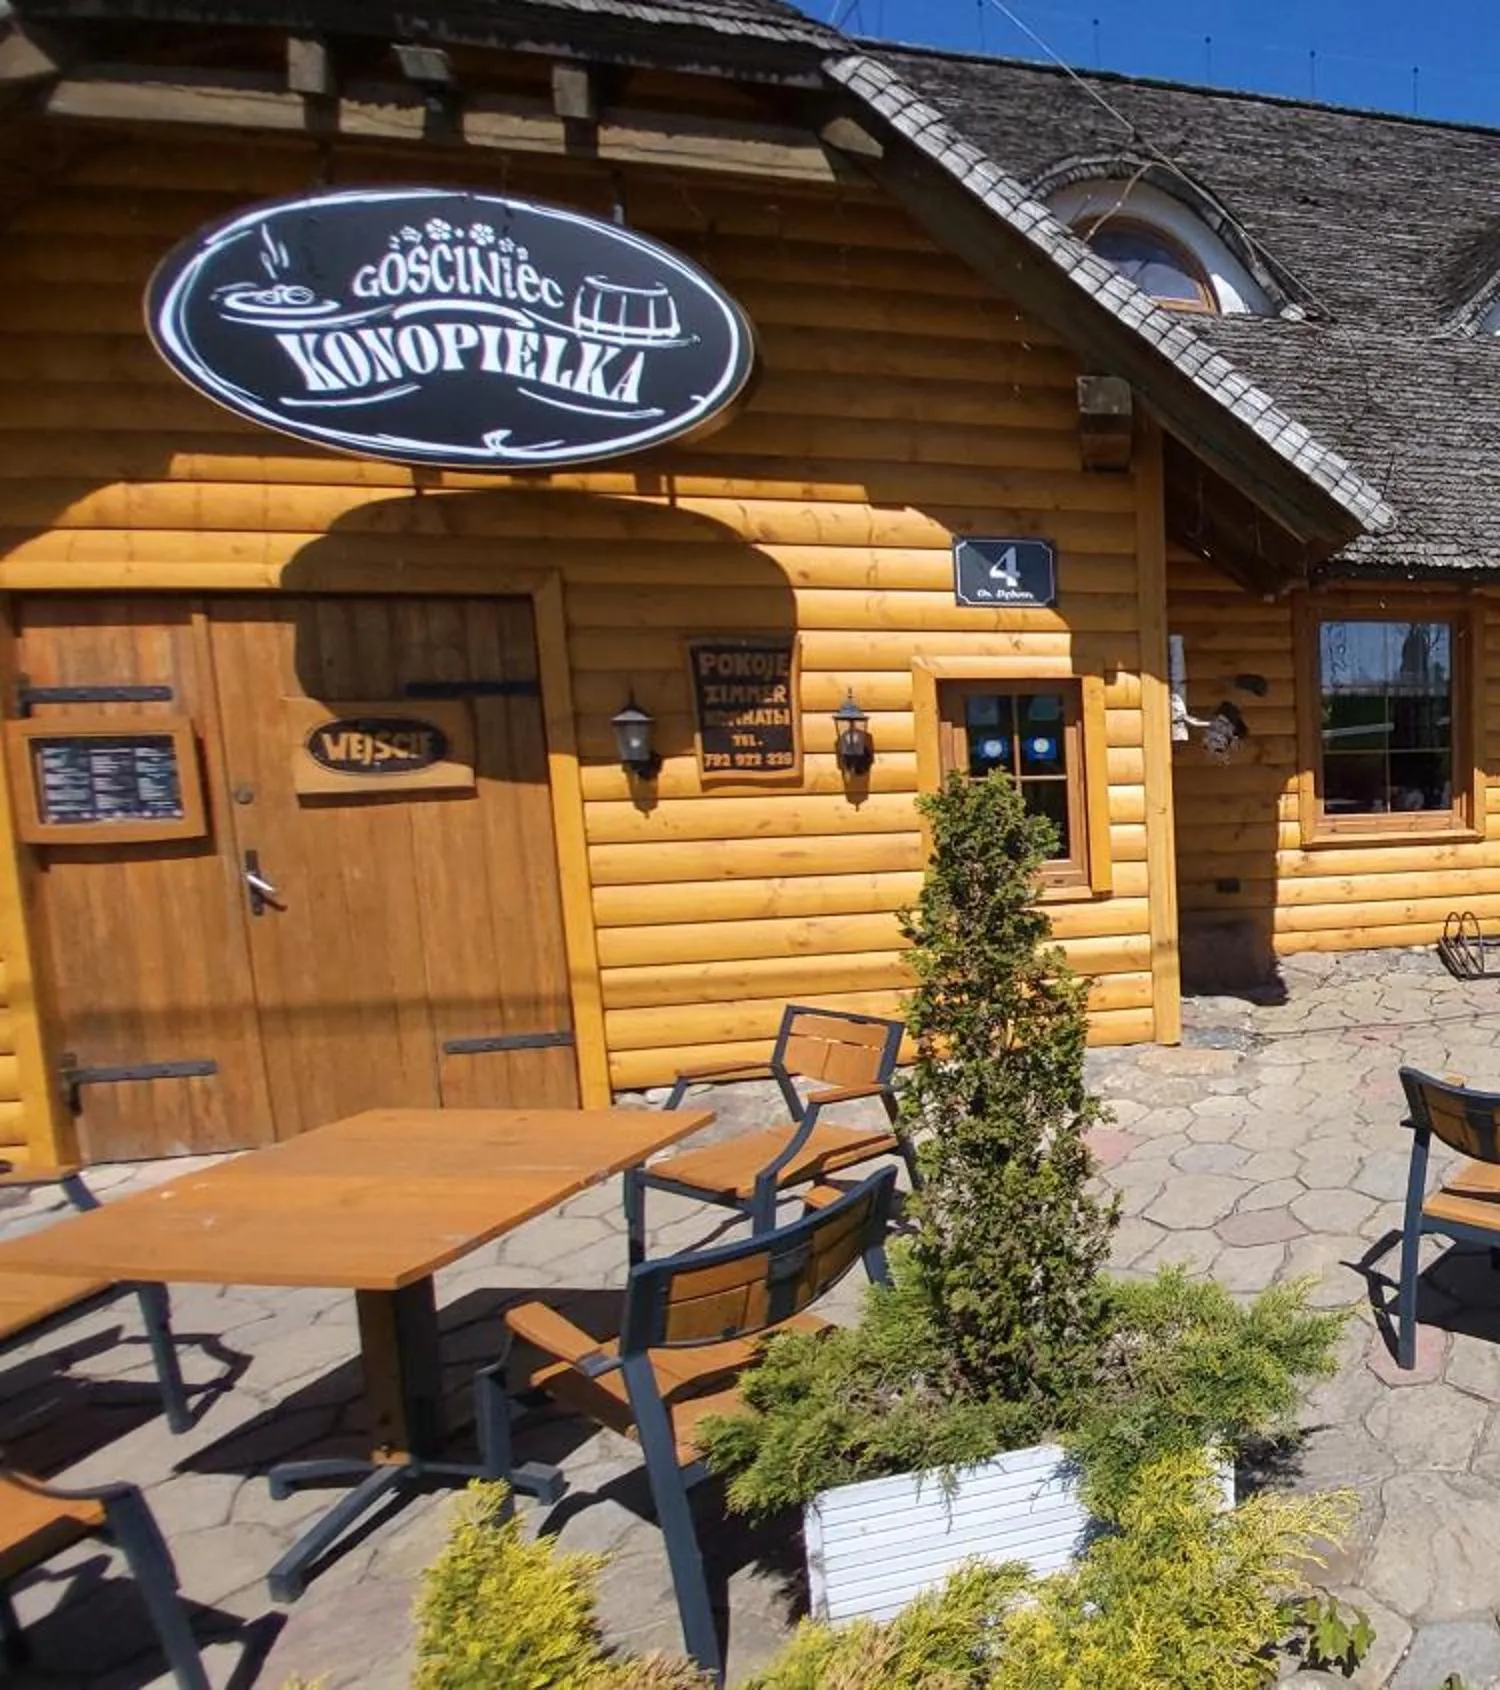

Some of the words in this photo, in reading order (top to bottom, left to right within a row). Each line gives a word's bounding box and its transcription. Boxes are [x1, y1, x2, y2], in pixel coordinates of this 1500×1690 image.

[275, 323, 646, 404] KONOPIELKA
[989, 546, 1021, 587] 4
[731, 734, 764, 747] TEL.
